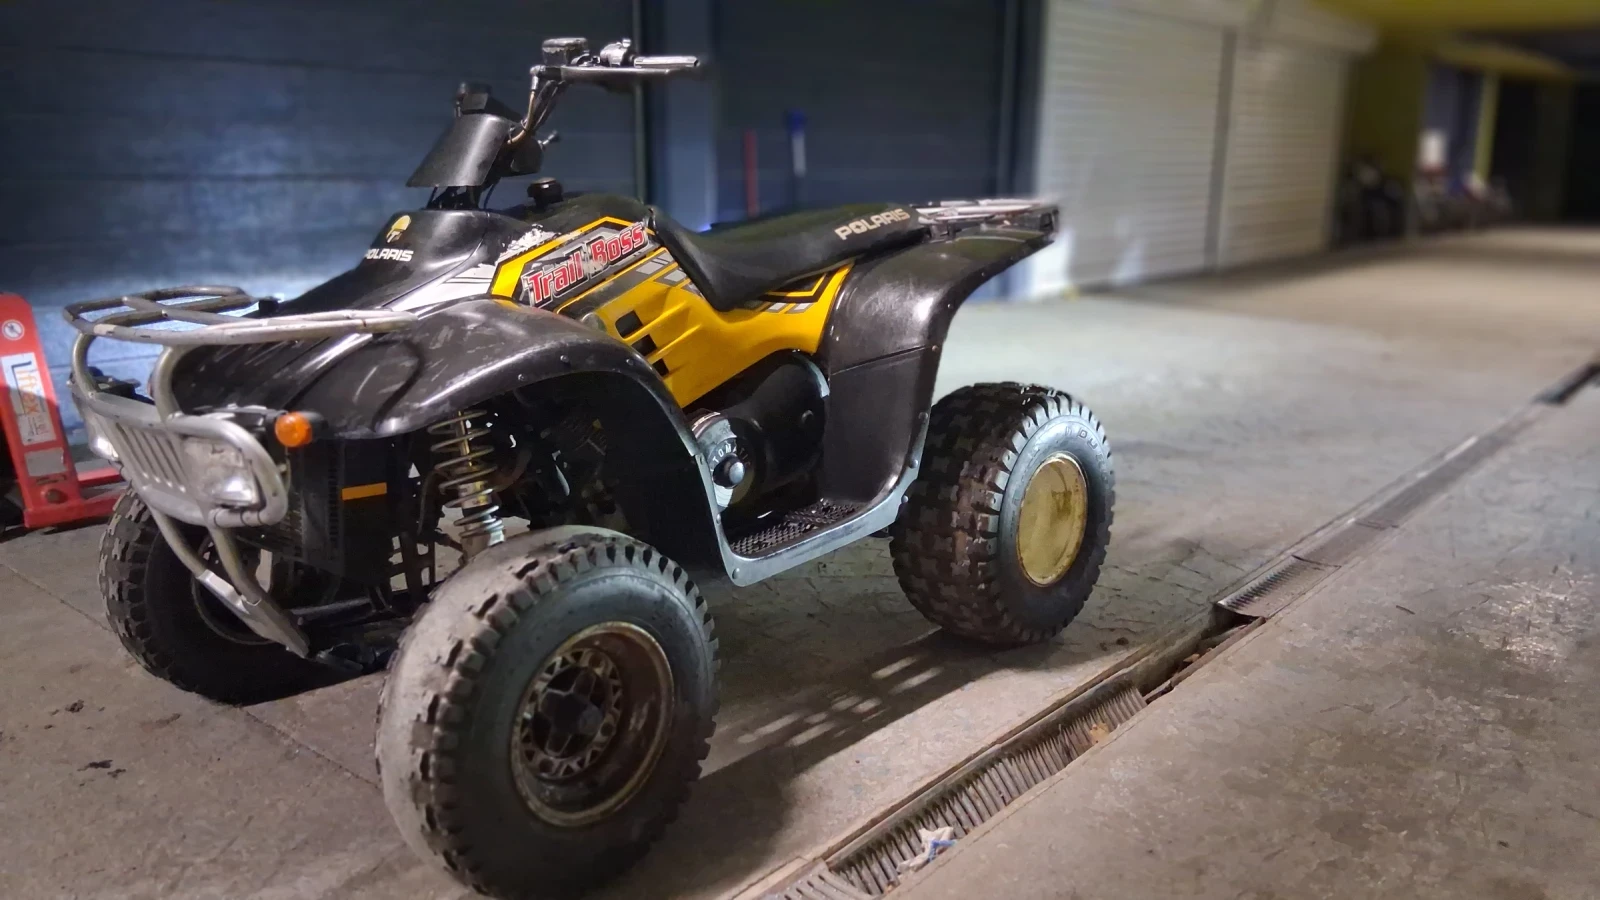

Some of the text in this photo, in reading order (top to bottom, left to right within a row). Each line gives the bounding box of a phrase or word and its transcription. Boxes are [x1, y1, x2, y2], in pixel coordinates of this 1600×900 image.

[834, 208, 911, 241] POLARIS
[527, 223, 649, 303] Trail Boss
